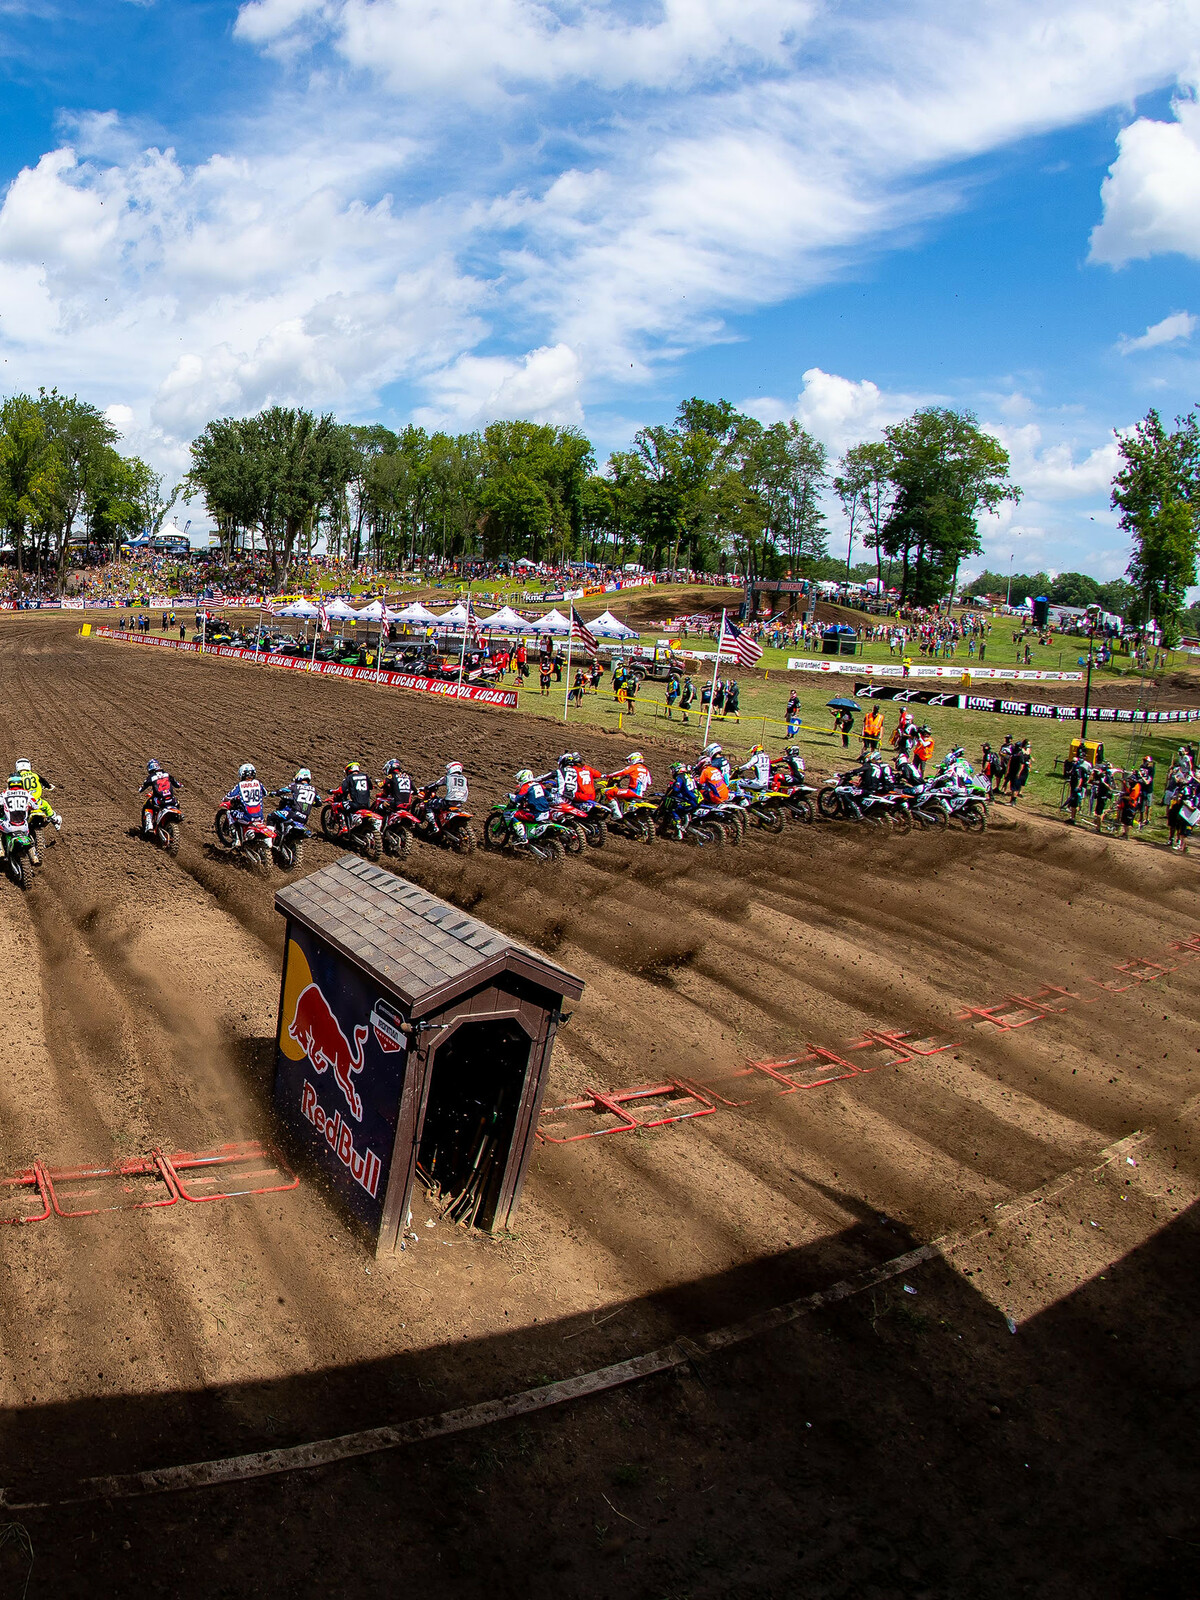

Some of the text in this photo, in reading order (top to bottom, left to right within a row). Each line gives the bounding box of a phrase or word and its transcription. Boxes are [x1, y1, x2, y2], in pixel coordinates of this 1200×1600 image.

[622, 578, 642, 588] LUCAS
[585, 588, 601, 596] KTM
[2, 601, 14, 610] OIL
[245, 597, 257, 605] OIL
[795, 661, 821, 670] guaranteed
[178, 642, 189, 650] LUCAS
[197, 645, 210, 653] LCAS
[219, 648, 232, 656] LUCAS
[242, 651, 257, 661] LUCAS
[267, 655, 283, 665] LUCAS
[284, 659, 292, 667] OIL
[294, 659, 312, 670] LUCAS
[313, 663, 322, 672] OIL
[323, 664, 343, 675] LUCAS
[343, 668, 353, 677] OIL
[355, 669, 377, 681] LUCAS
[378, 673, 389, 683] OIL
[391, 675, 414, 687] LUCAS
[415, 680, 429, 690] OIL
[430, 682, 457, 695] LUCAS
[459, 686, 472, 698] OIL
[474, 689, 503, 703] LUCAS
[504, 694, 516, 705] OIL
[968, 697, 995, 707] KMC
[1001, 700, 1027, 711] KMC
[1031, 704, 1053, 714] KMC
[1056, 707, 1077, 716] KMC
[1100, 709, 1116, 717] KMC
[356, 780, 367, 791] 43
[398, 778, 411, 790] 23
[453, 777, 464, 787] 19
[243, 789, 260, 802] 349
[297, 790, 315, 804] 20
[8, 797, 26, 811] 309
[375, 1030, 398, 1049] NATIONAL
